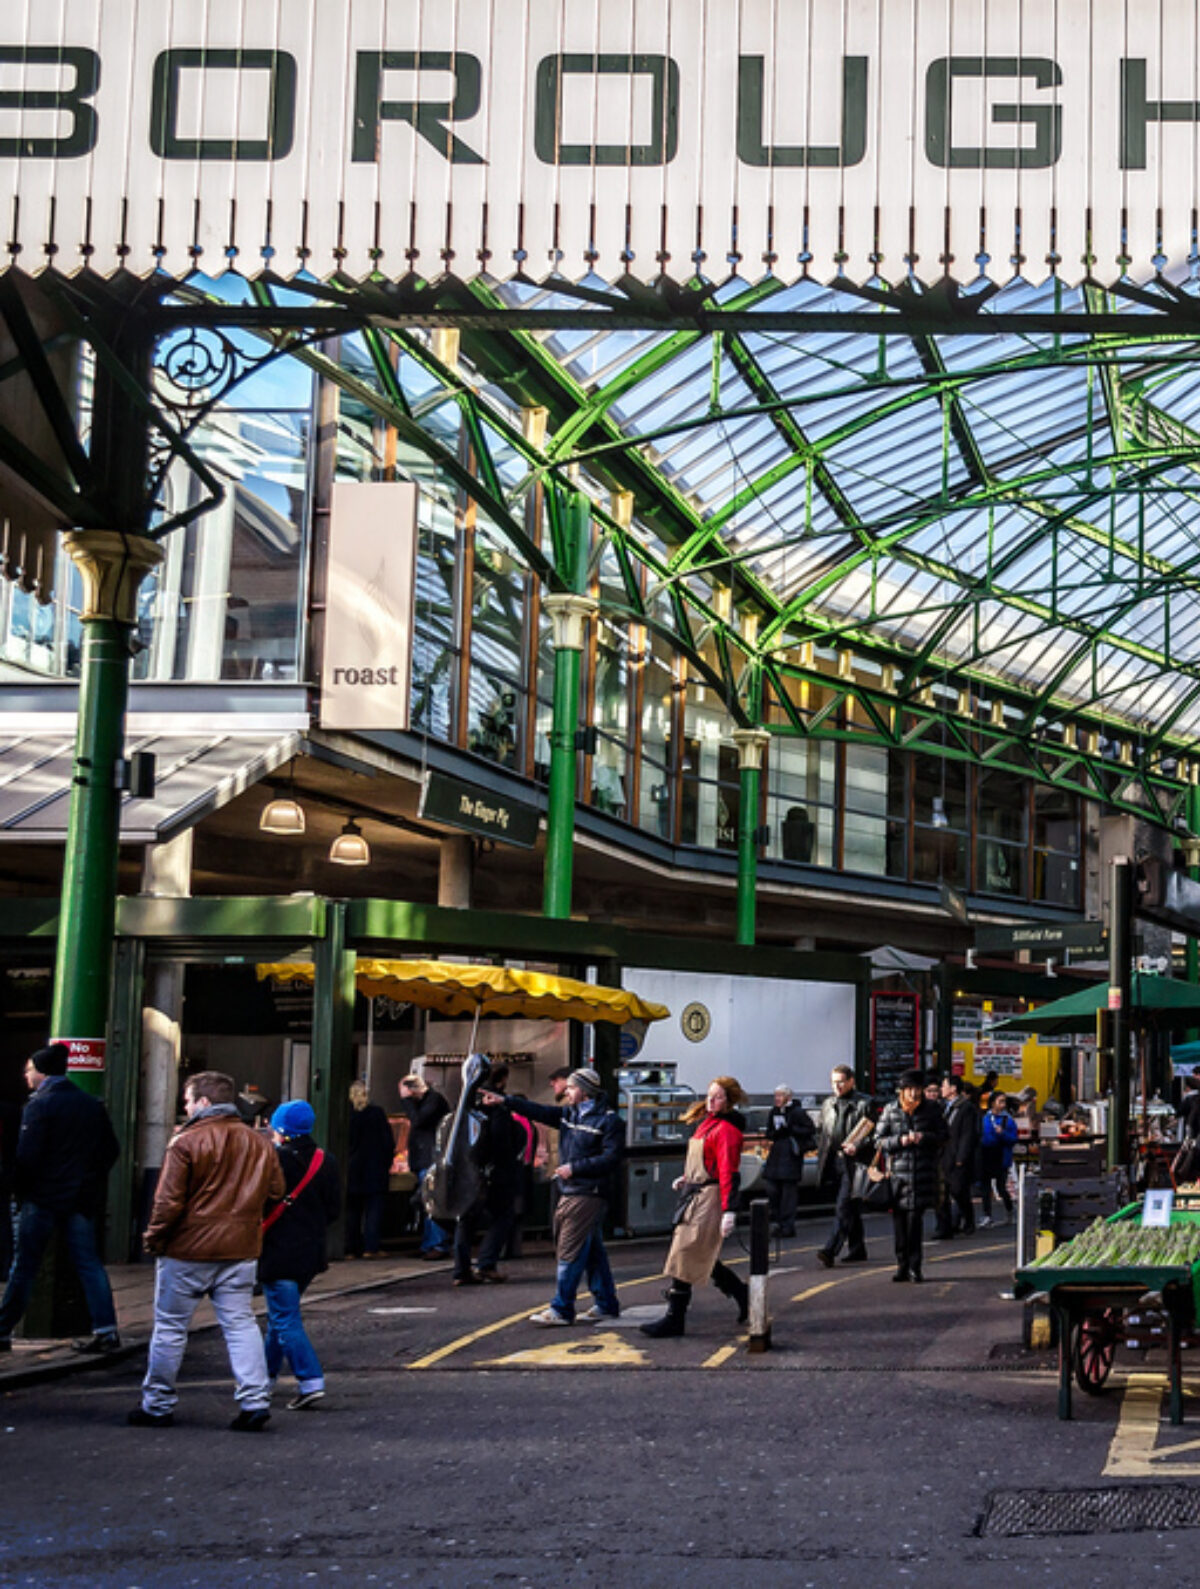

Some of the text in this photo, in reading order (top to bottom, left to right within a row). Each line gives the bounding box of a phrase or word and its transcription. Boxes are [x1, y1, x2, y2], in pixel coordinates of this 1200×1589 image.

[332, 665, 399, 686] roast
[70, 1042, 90, 1053] No
[67, 1054, 102, 1067] oking
